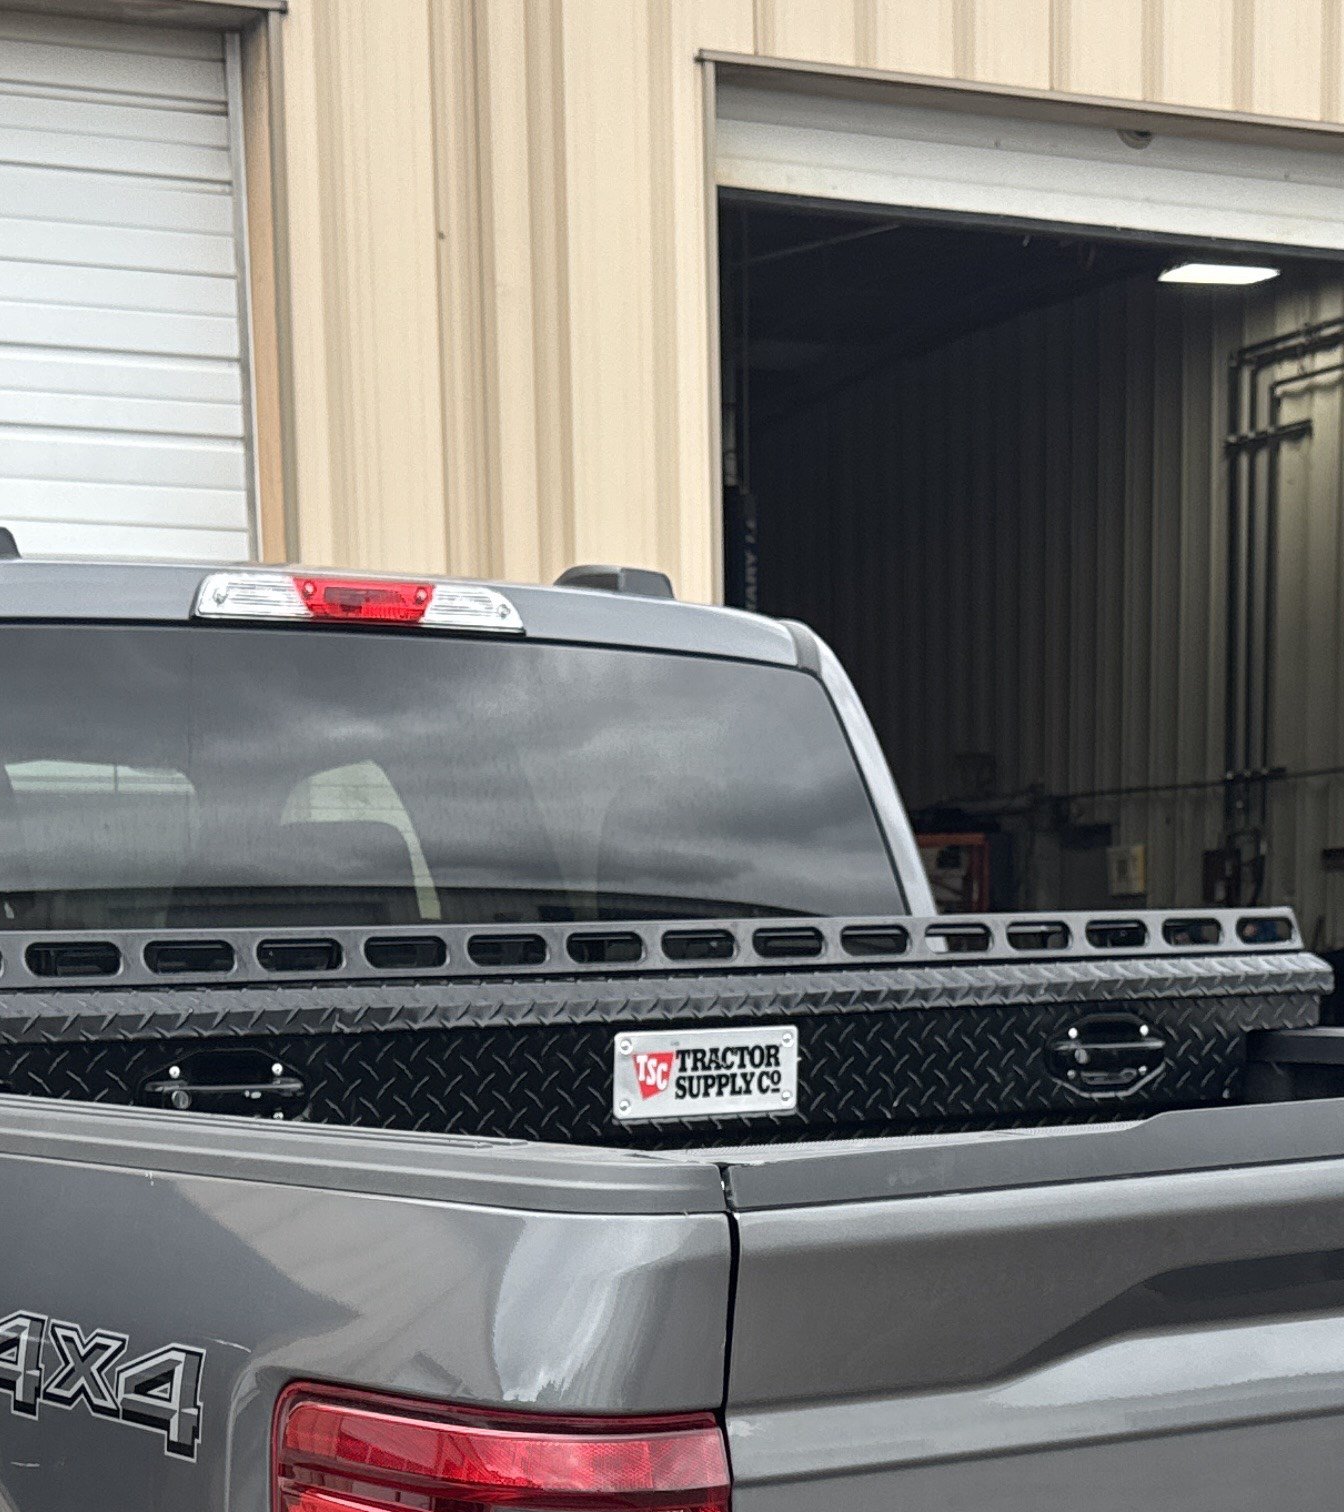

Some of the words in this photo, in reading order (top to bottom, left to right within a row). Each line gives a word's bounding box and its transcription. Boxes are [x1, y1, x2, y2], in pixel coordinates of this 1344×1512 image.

[636, 1055, 668, 1091] TSC
[675, 1044, 781, 1073] TRACTOR
[675, 1073, 753, 1101] SUPPLY
